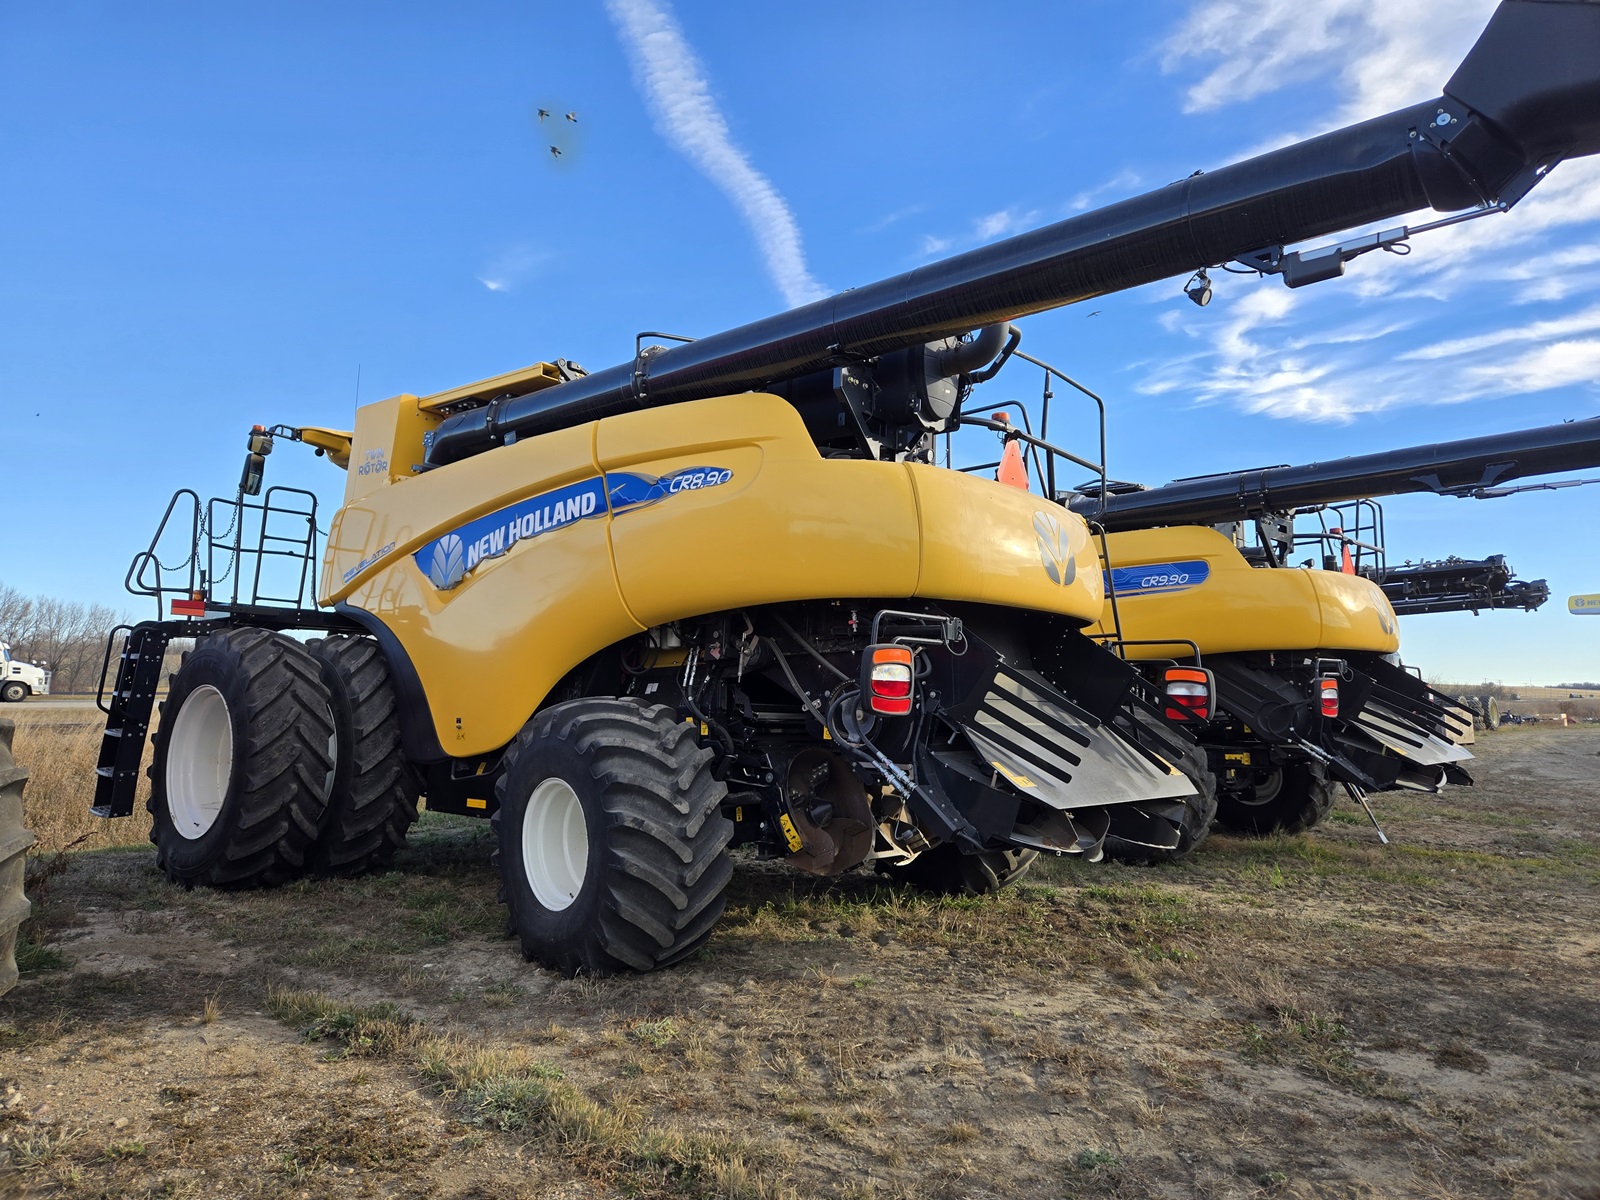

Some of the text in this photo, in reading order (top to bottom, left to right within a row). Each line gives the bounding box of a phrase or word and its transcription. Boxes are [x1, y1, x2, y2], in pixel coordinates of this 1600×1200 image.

[365, 447, 385, 460] TWIN
[358, 460, 388, 476] ROTOR
[669, 470, 732, 493] CR8.90
[467, 491, 596, 569] NEW HOLLAND
[343, 541, 396, 580] REVELATION
[1141, 573, 1189, 588] CR9.90
